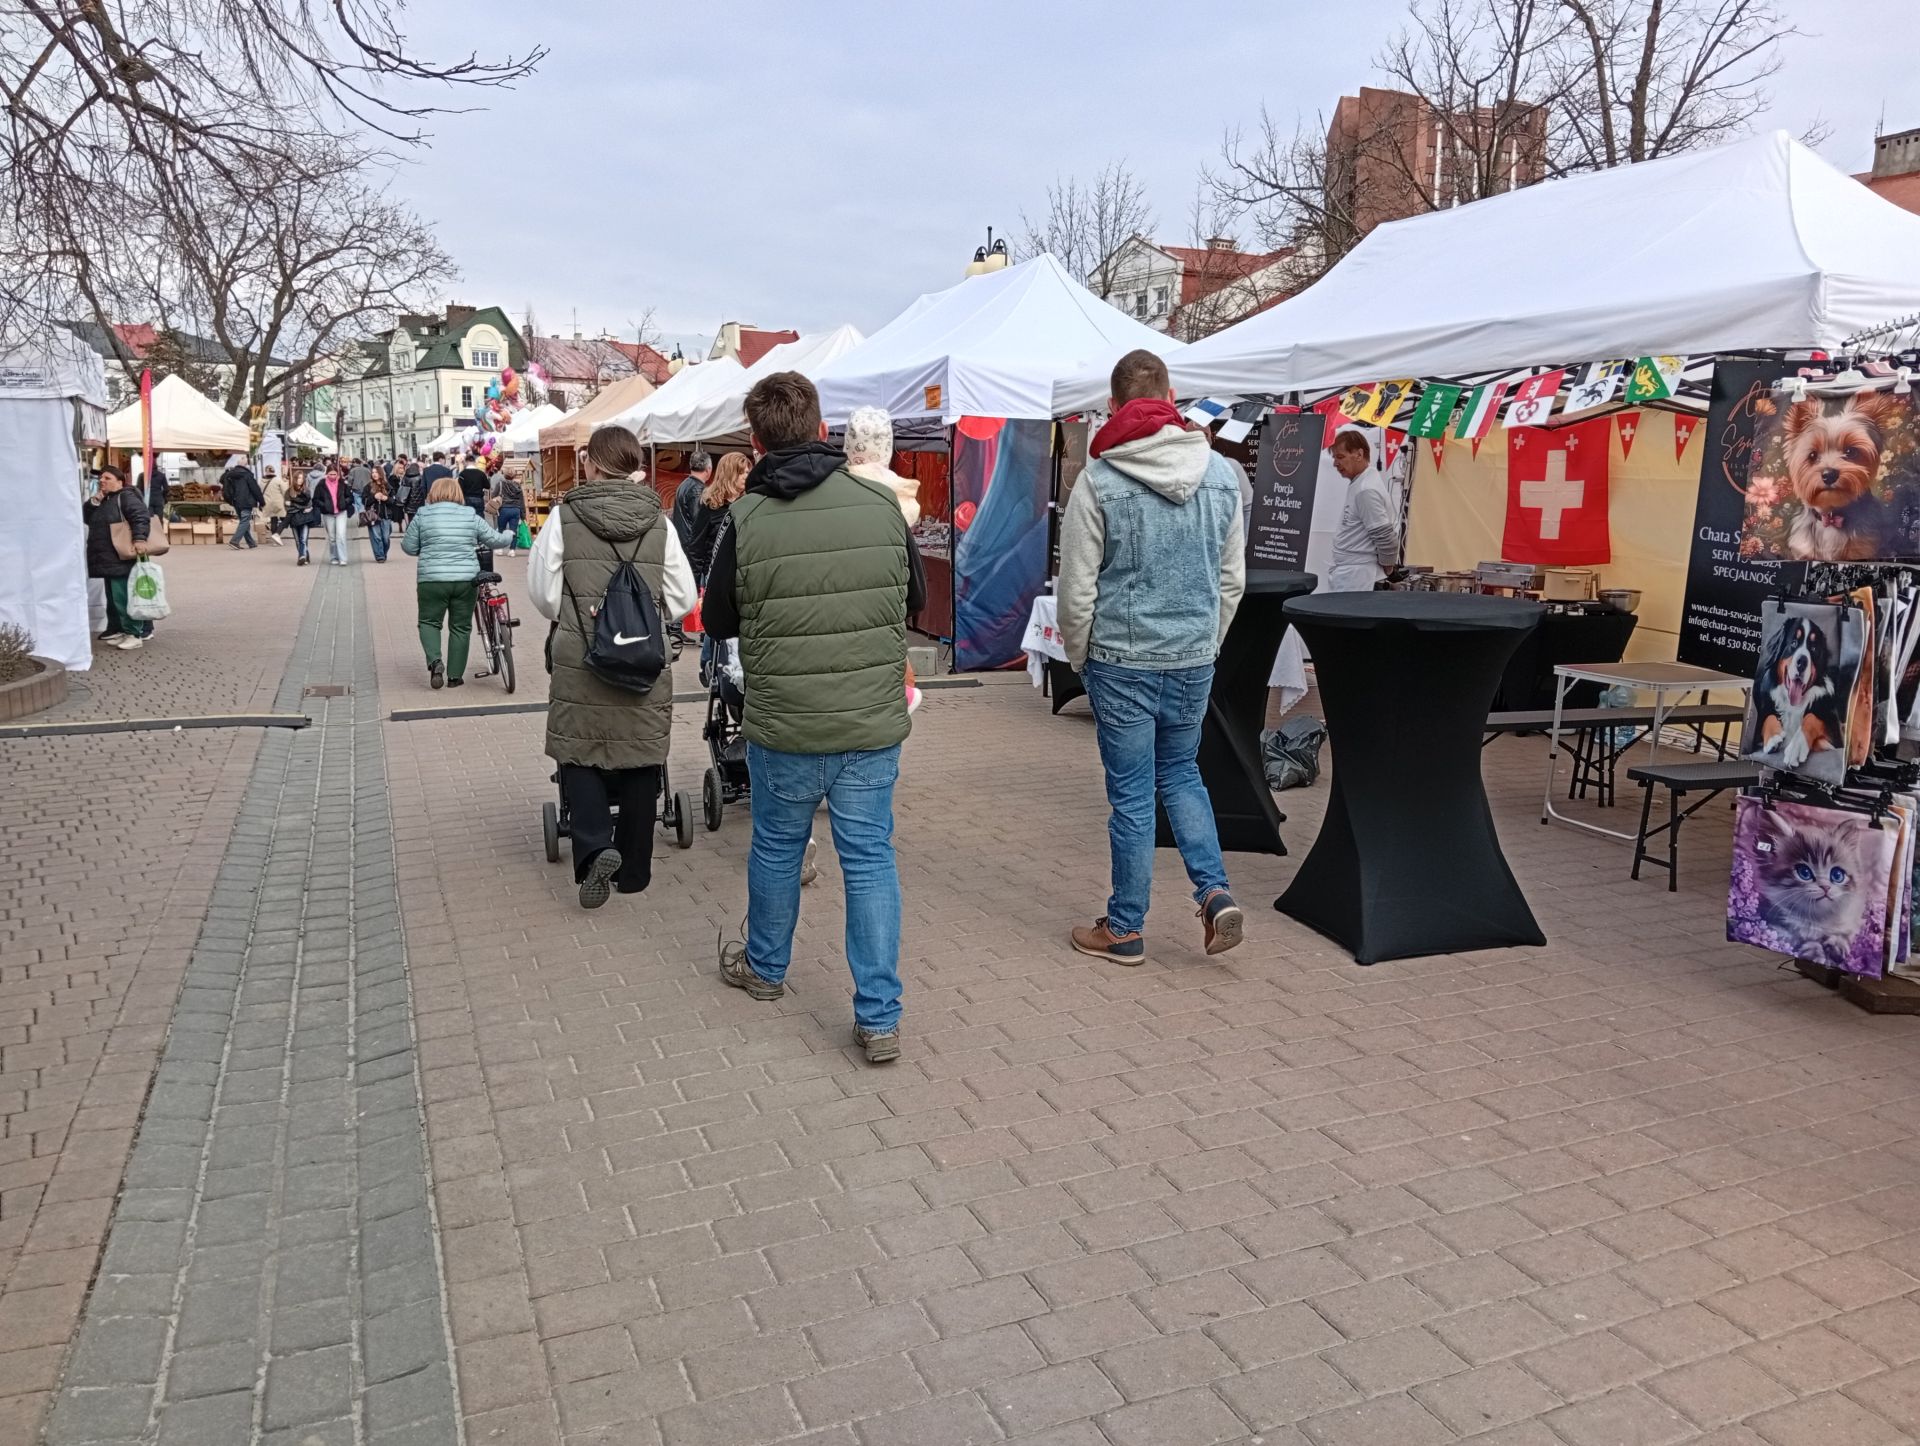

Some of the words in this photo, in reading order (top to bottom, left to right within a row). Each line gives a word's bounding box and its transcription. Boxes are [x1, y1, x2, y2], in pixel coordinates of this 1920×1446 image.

[1273, 482, 1294, 497] Porcja
[1263, 495, 1273, 506] Ser
[1274, 496, 1302, 509] Raclette
[1271, 512, 1277, 520] z
[1277, 510, 1289, 524] Alp
[1699, 526, 1731, 543] Chata
[1711, 549, 1735, 562] SERY
[1713, 565, 1776, 585] SPECJALNOŚĆ
[1691, 603, 1763, 624] www.chata-szwajcars
[1688, 615, 1762, 639] info@chata-szwajcars
[1699, 633, 1711, 642] tel.
[1712, 636, 1726, 646] +48
[1727, 638, 1741, 649] 530
[1742, 641, 1756, 652] 826
